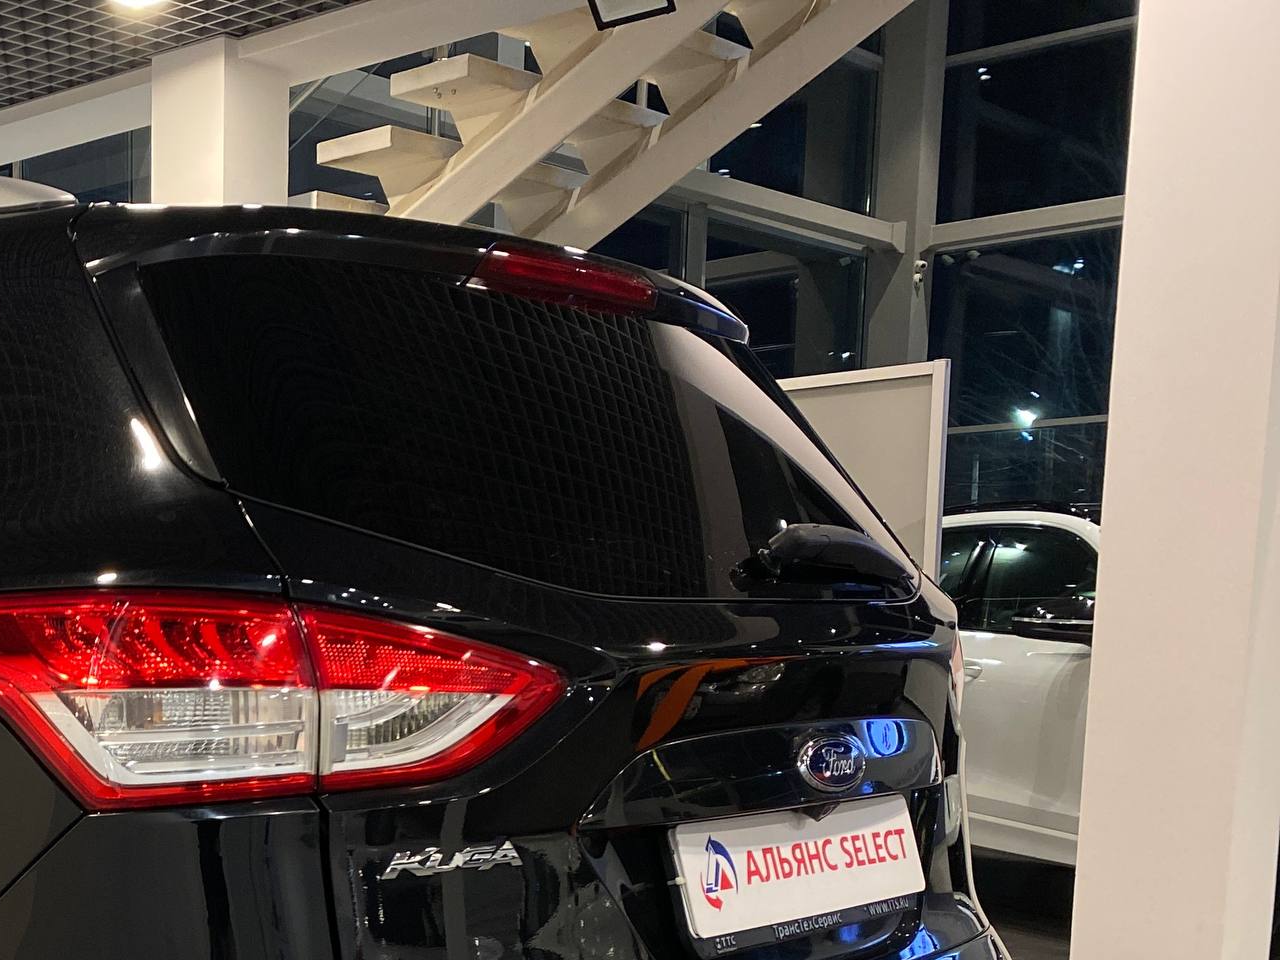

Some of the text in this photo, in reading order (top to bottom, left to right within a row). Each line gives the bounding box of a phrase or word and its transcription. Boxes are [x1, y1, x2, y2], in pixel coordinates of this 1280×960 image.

[821, 746, 855, 777] Ford
[381, 840, 523, 880] KUGA
[746, 829, 907, 886] АЛЬЯНС SELECT
[773, 914, 843, 940] ТрансТехСервис
